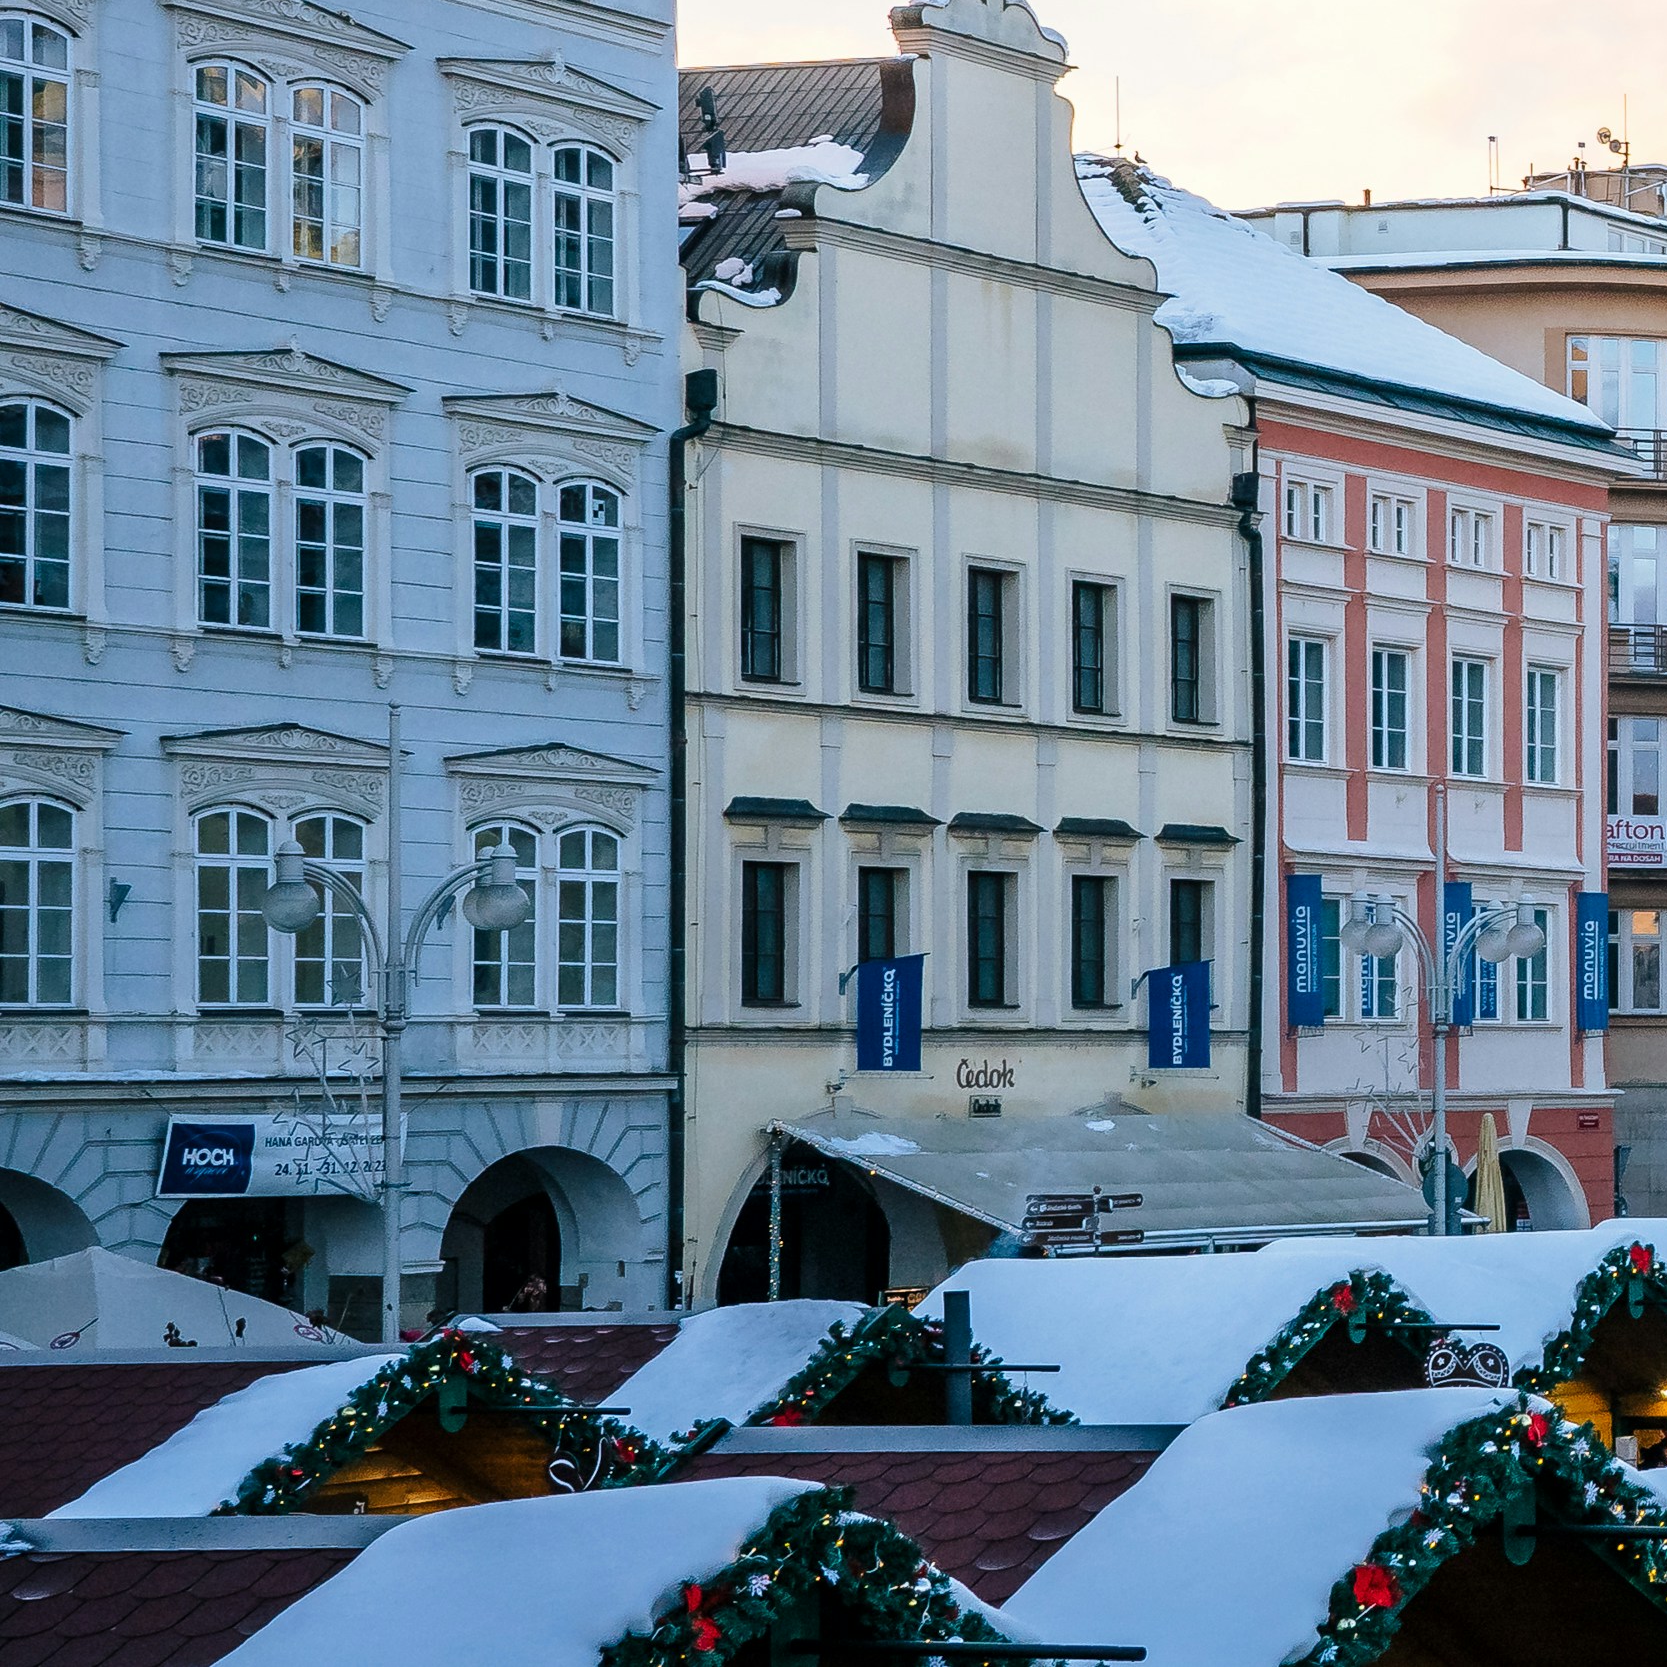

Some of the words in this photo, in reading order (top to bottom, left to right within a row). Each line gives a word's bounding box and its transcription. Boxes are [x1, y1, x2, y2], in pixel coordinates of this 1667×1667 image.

[1607, 819, 1665, 840] afton
[1292, 906, 1307, 993] manuvia
[1580, 920, 1596, 1000] manuvia
[956, 1058, 1015, 1089] Čedok
[264, 1136, 292, 1147] HANA
[182, 1147, 234, 1166] HOCH
[274, 1163, 292, 1176] 24.
